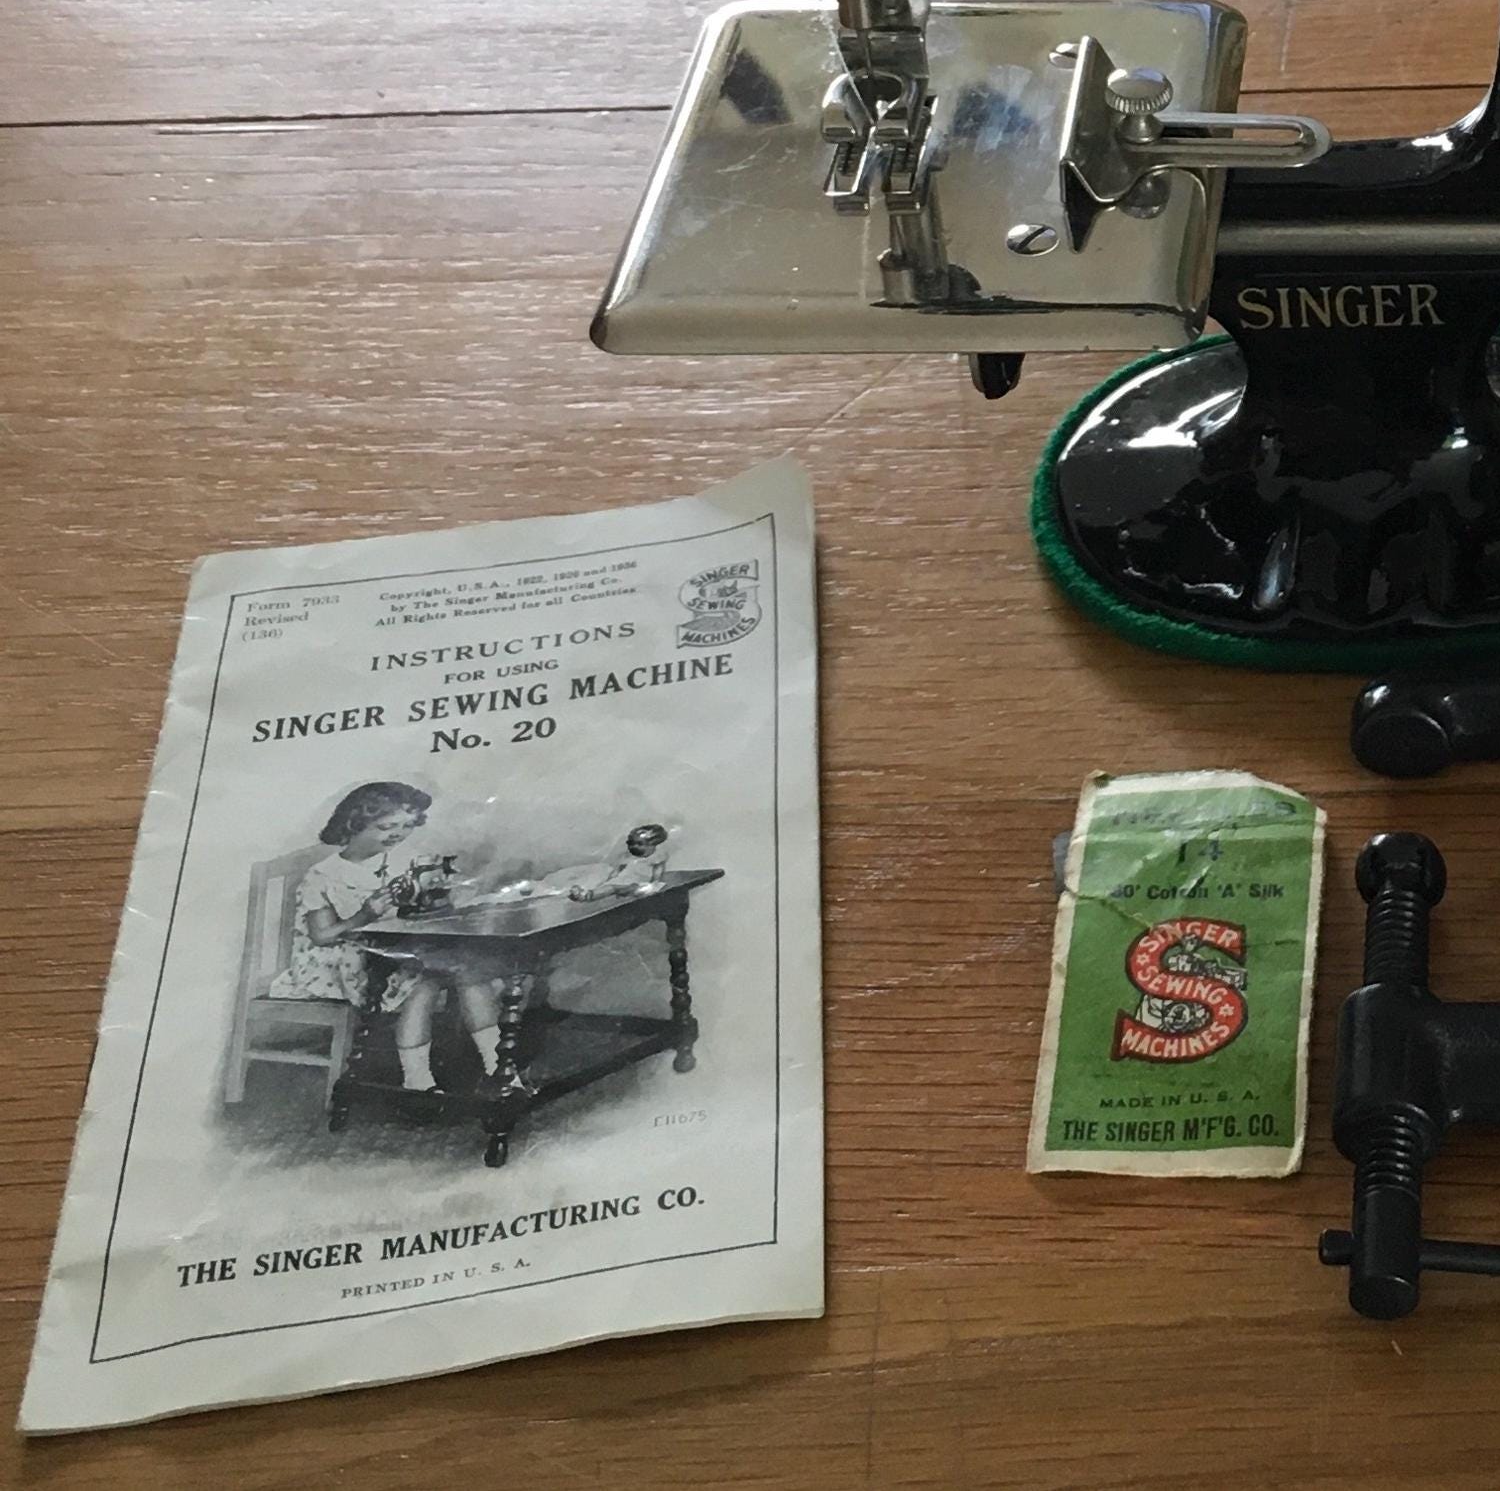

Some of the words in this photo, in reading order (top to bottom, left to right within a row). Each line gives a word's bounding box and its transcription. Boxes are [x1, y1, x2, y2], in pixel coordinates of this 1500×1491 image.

[1237, 283, 1446, 330] SINGER
[689, 563, 750, 589] SINGER
[246, 601, 291, 613] Form
[375, 617, 396, 627] All
[403, 611, 447, 624] Rights
[453, 603, 516, 617] Reserved
[521, 599, 541, 609] for
[545, 596, 564, 607] all
[390, 603, 407, 614] by
[413, 600, 440, 609] The
[445, 595, 489, 608] Singer
[495, 580, 596, 601] Manufacturing
[686, 596, 747, 611] SEWING
[244, 611, 310, 627] Revised
[680, 616, 756, 644] MACHINES
[370, 621, 637, 671] INSTRUCTIONS
[443, 667, 486, 685] FOR
[496, 658, 560, 680] USING
[252, 705, 386, 743] SINGER
[407, 684, 549, 723] SEWING
[569, 653, 736, 700] MACHINE
[429, 726, 492, 753] No.
[511, 716, 557, 744] 20
[1249, 883, 1286, 900] Silk
[1139, 921, 1239, 952] SINGER
[1136, 965, 1228, 1005] SEWING
[1120, 1021, 1230, 1058] MACHINES
[1100, 1095, 1154, 1109] MADE
[1161, 1094, 1182, 1107] IN
[1063, 1118, 1098, 1142] THE
[1105, 1117, 1176, 1142] SINGER
[1248, 1114, 1280, 1138] CO.
[177, 1258, 238, 1289] THE
[253, 1240, 363, 1277] SINGER
[380, 1195, 642, 1262] MANUFACTURING
[656, 1185, 706, 1212] CO.
[340, 1275, 426, 1300] PRINTED
[432, 1270, 457, 1285] IN
